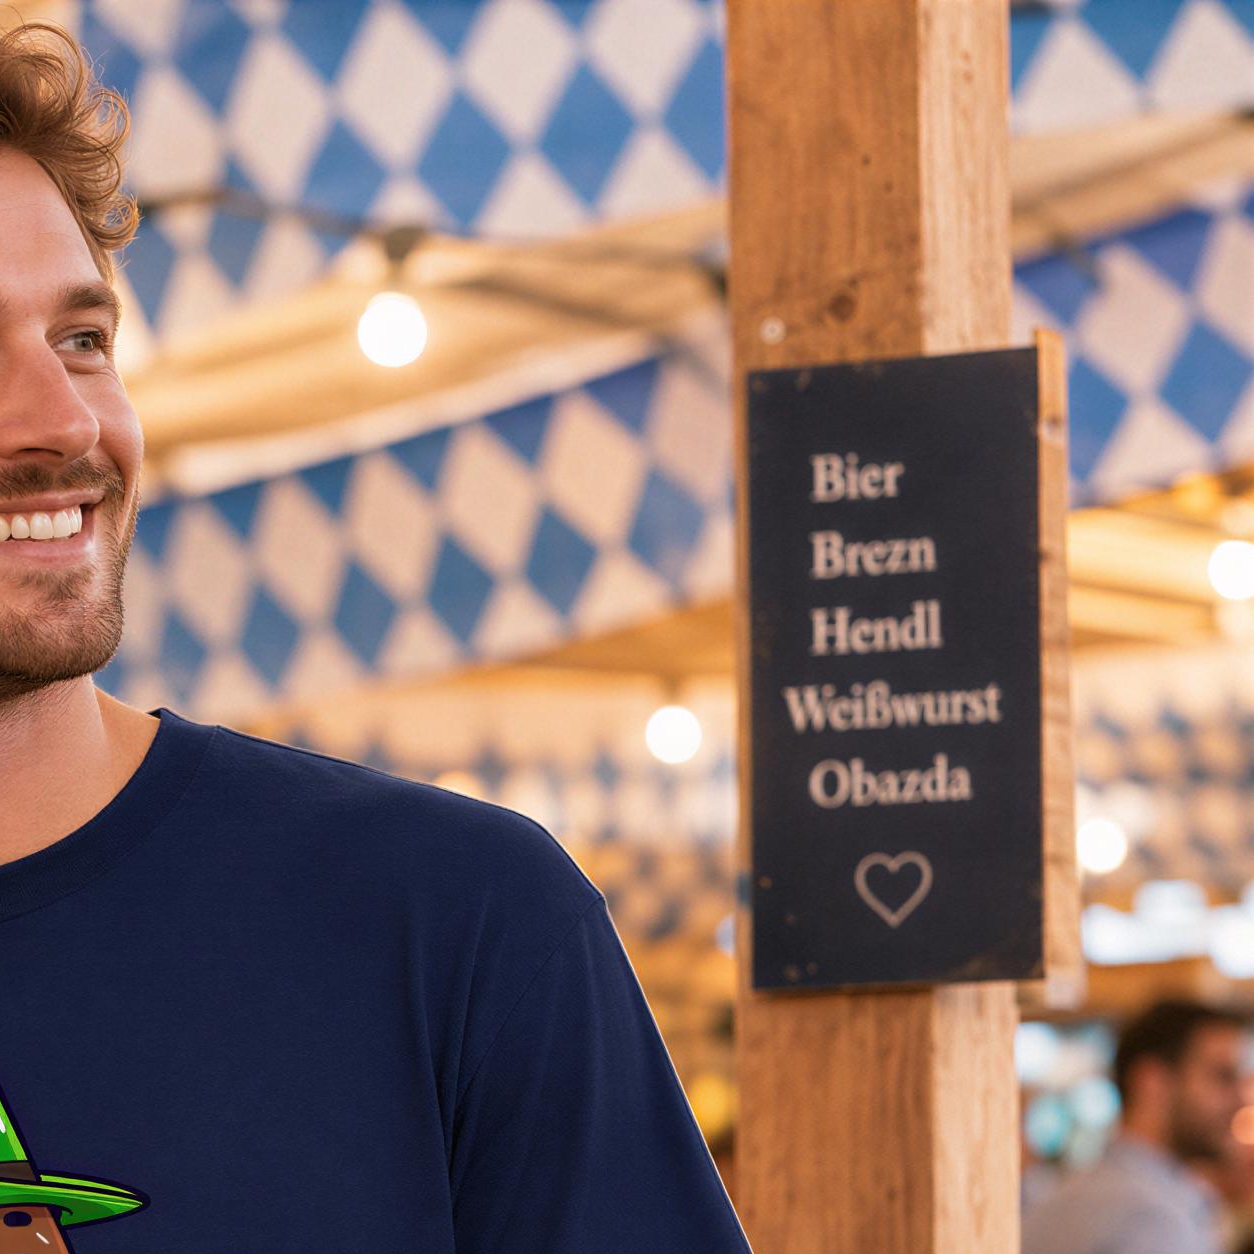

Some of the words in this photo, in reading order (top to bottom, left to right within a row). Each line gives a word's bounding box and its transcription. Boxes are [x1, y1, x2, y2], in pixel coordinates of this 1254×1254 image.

[811, 452, 905, 503] Bier
[810, 529, 938, 579] Brezn
[810, 598, 943, 656] Hendl
[783, 679, 1002, 731] Weißwurst
[807, 751, 973, 808] Obazda
